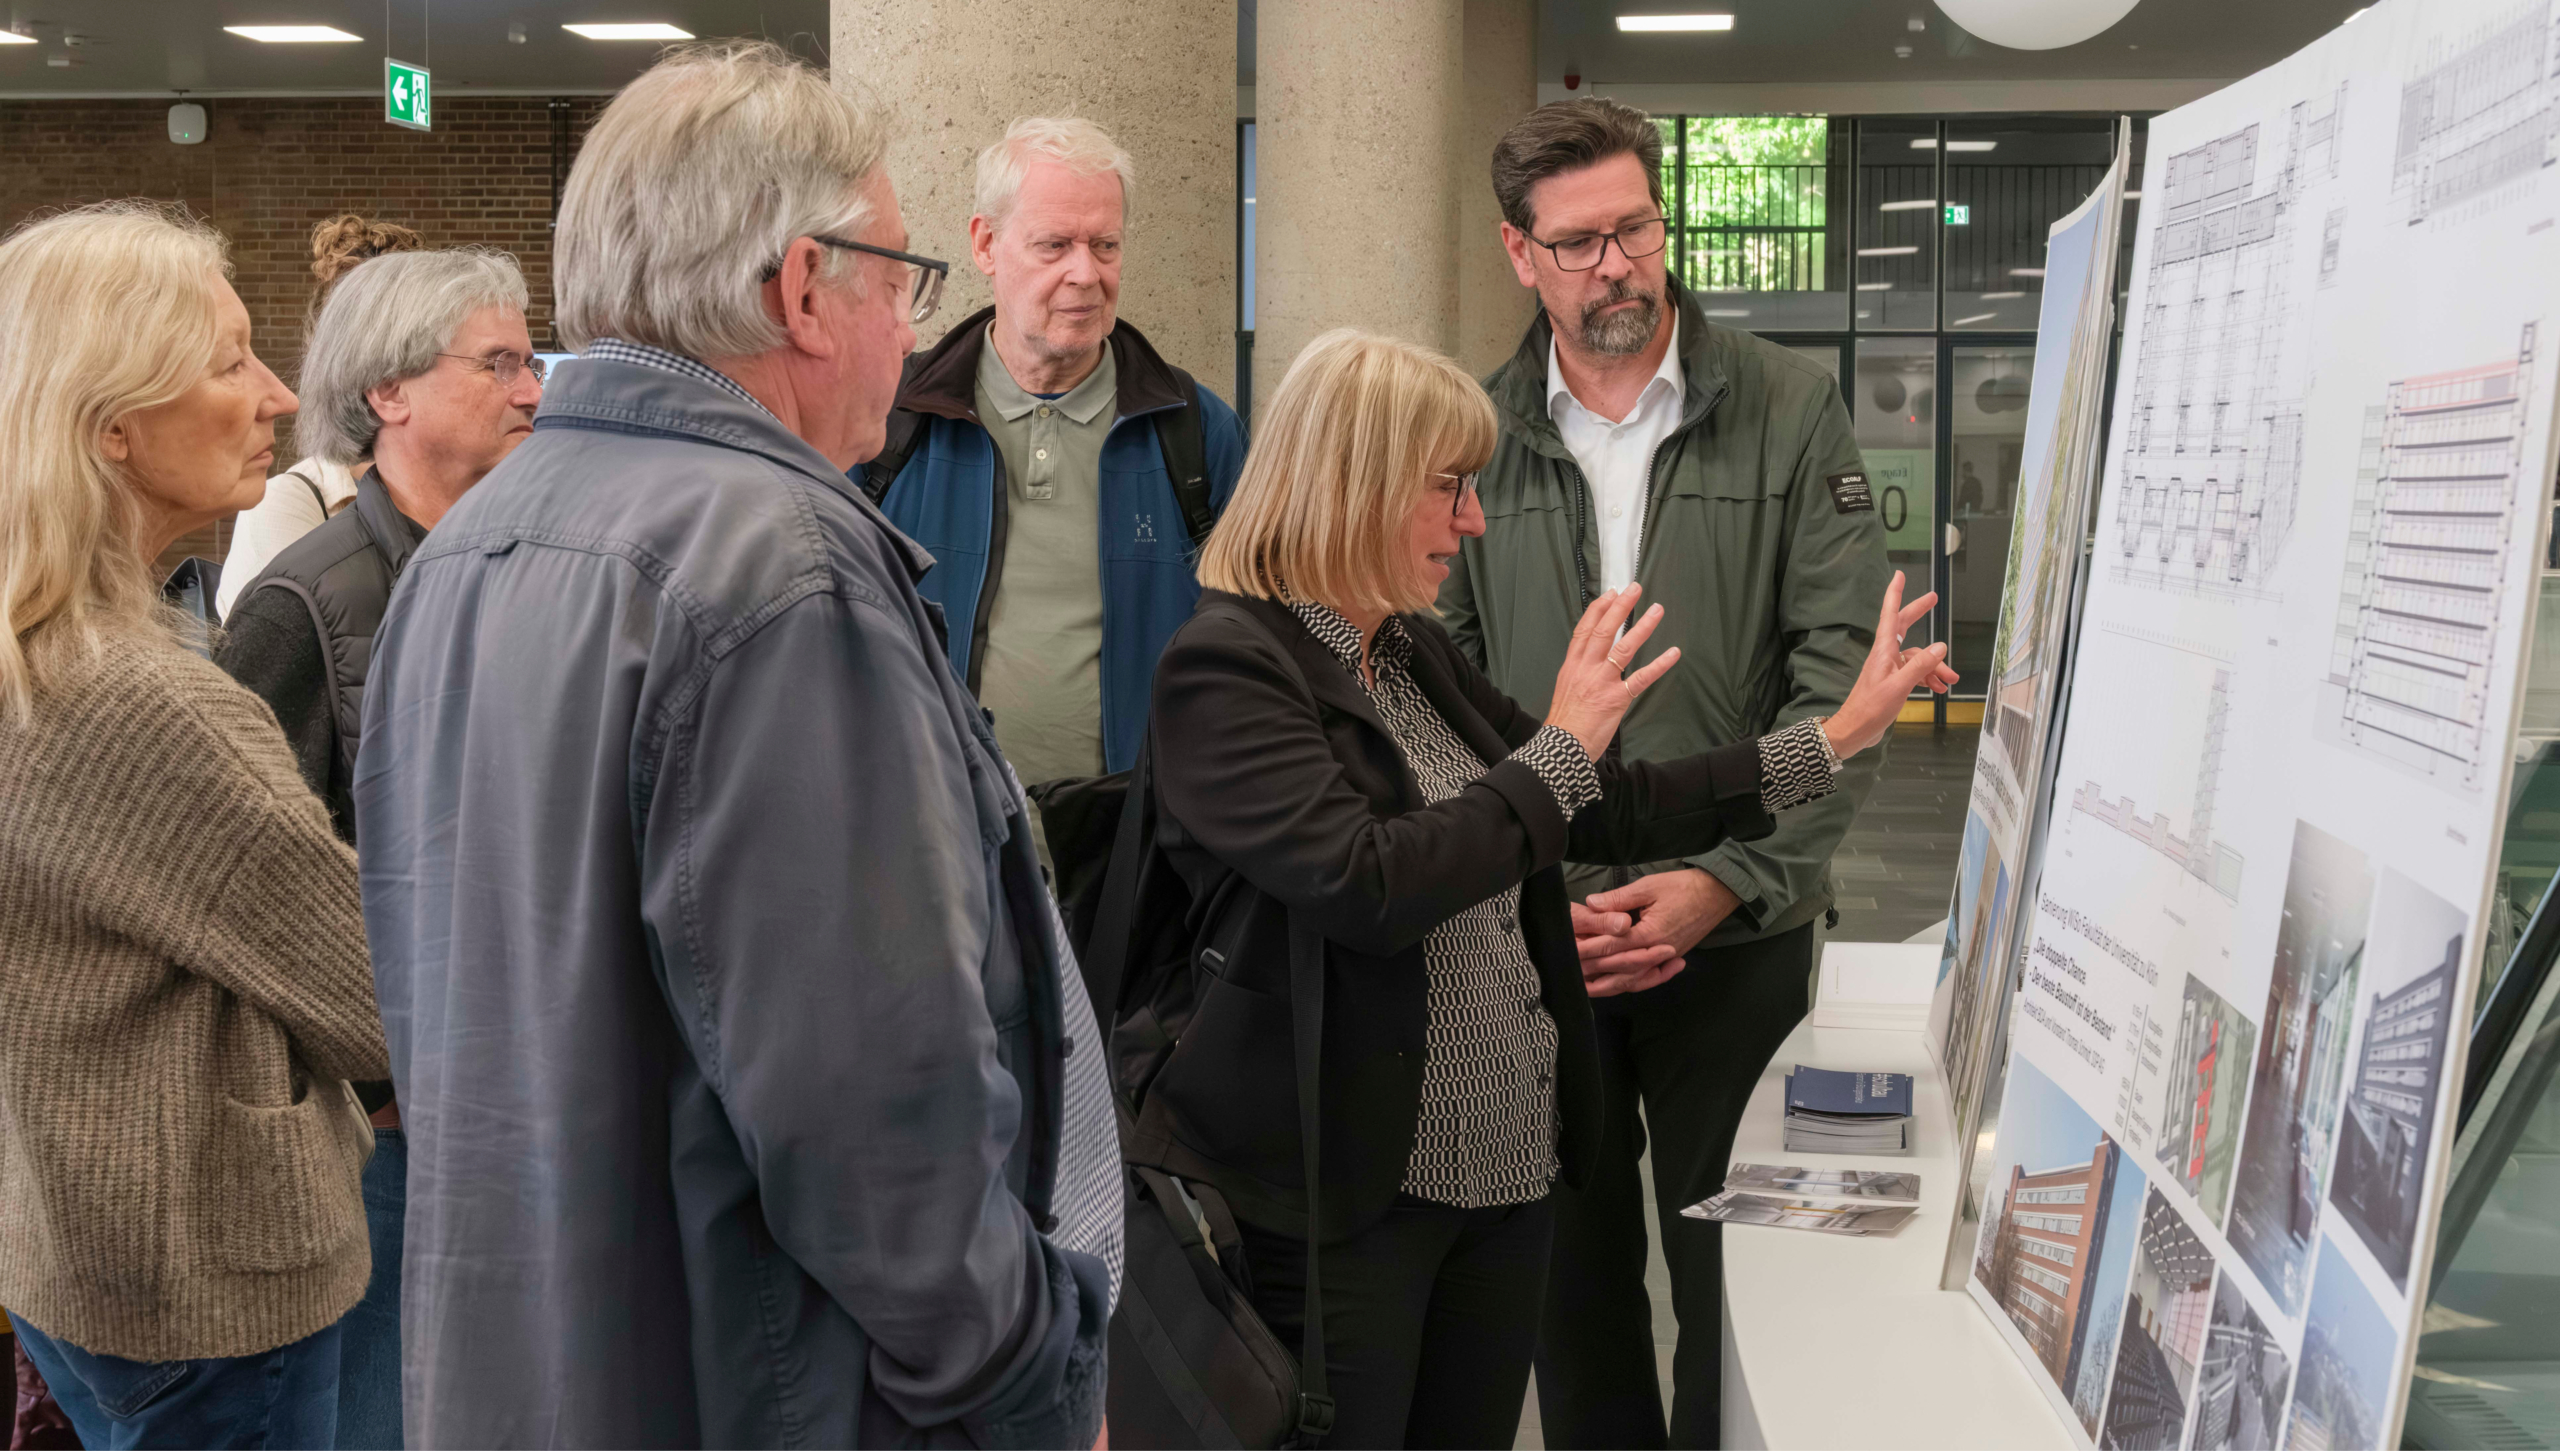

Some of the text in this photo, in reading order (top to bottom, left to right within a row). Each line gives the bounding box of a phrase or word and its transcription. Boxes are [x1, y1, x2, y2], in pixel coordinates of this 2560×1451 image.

[2041, 892, 2159, 988] Sanierung WiSo Fakultät der Universität zu Köln
[2045, 943, 2068, 971] doppelte
[2032, 966, 2042, 986] Der
[2041, 971, 2056, 997] beste
[2055, 982, 2078, 1012] Baustoff
[2075, 996, 2085, 1018] ist
[2082, 1003, 2093, 1024] der
